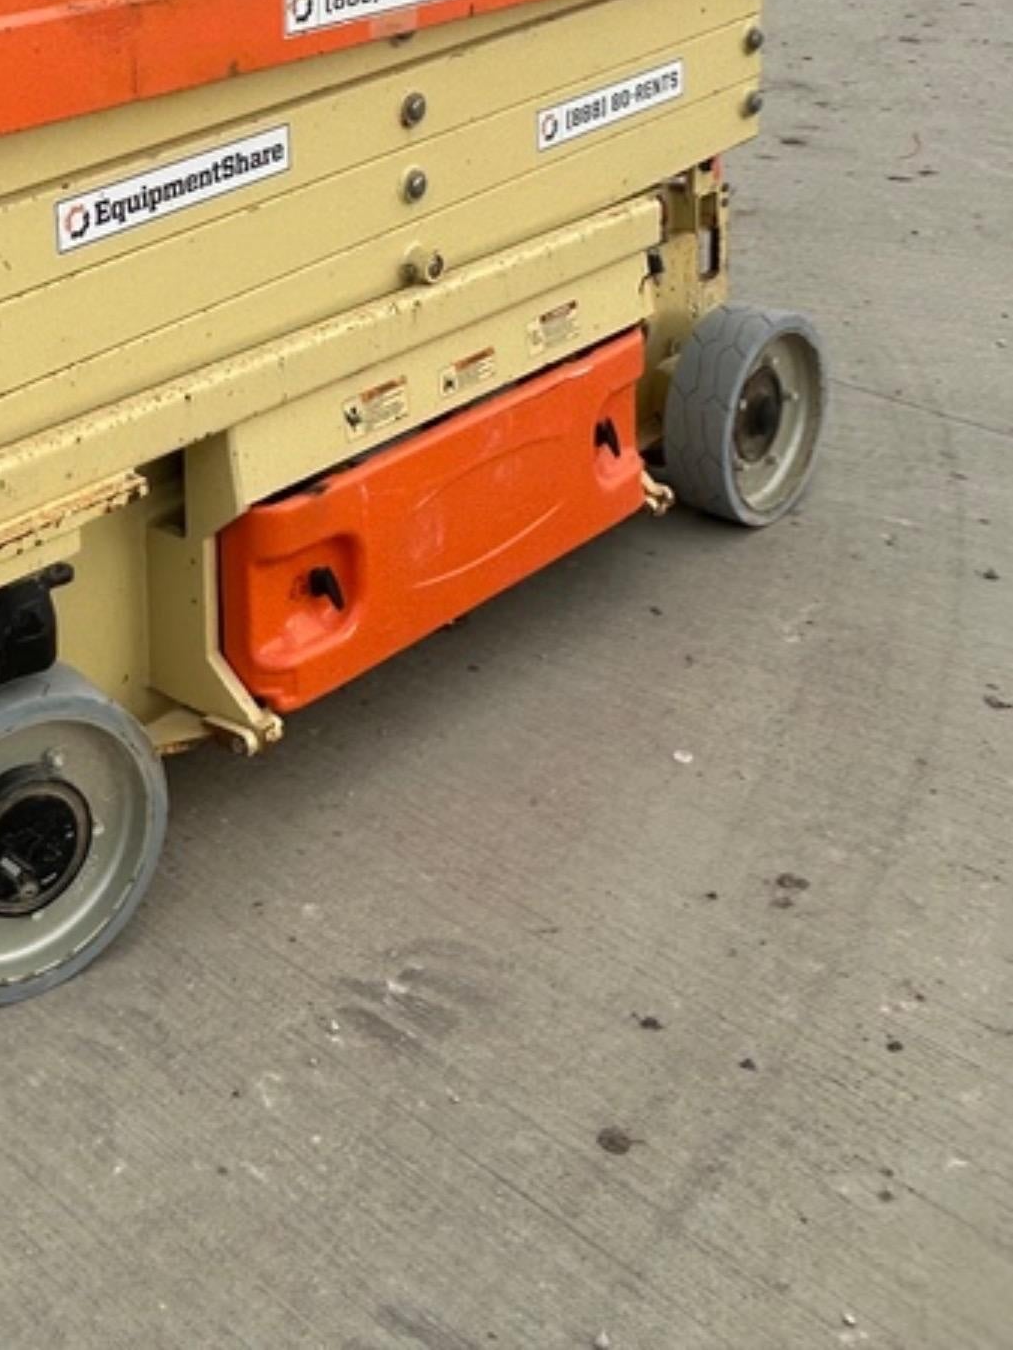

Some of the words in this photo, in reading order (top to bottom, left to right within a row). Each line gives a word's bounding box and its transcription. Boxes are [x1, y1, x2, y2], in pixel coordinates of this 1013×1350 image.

[565, 95, 607, 130] (888)
[611, 70, 679, 112] 80-RENTS
[93, 142, 285, 225] EquipmentShare
